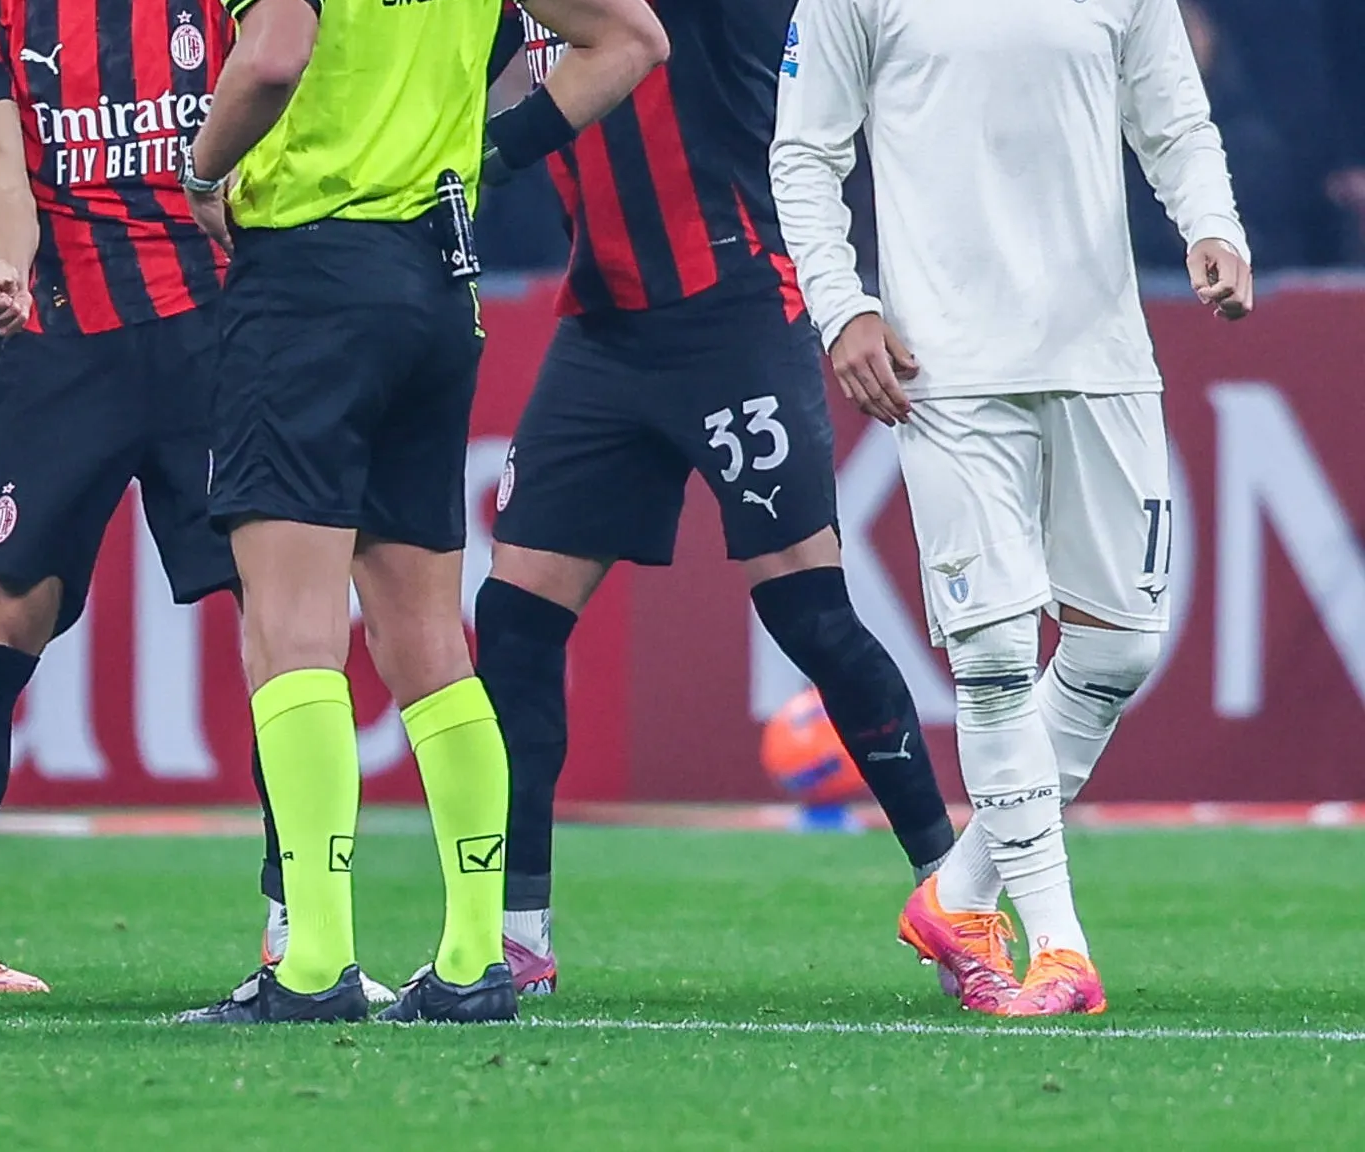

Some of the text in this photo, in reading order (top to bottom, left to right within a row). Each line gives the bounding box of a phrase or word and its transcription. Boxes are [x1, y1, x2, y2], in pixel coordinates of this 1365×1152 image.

[31, 88, 214, 145] Emirates
[56, 147, 98, 186] FLY
[704, 395, 789, 482] 33
[1143, 498, 1172, 574] 11
